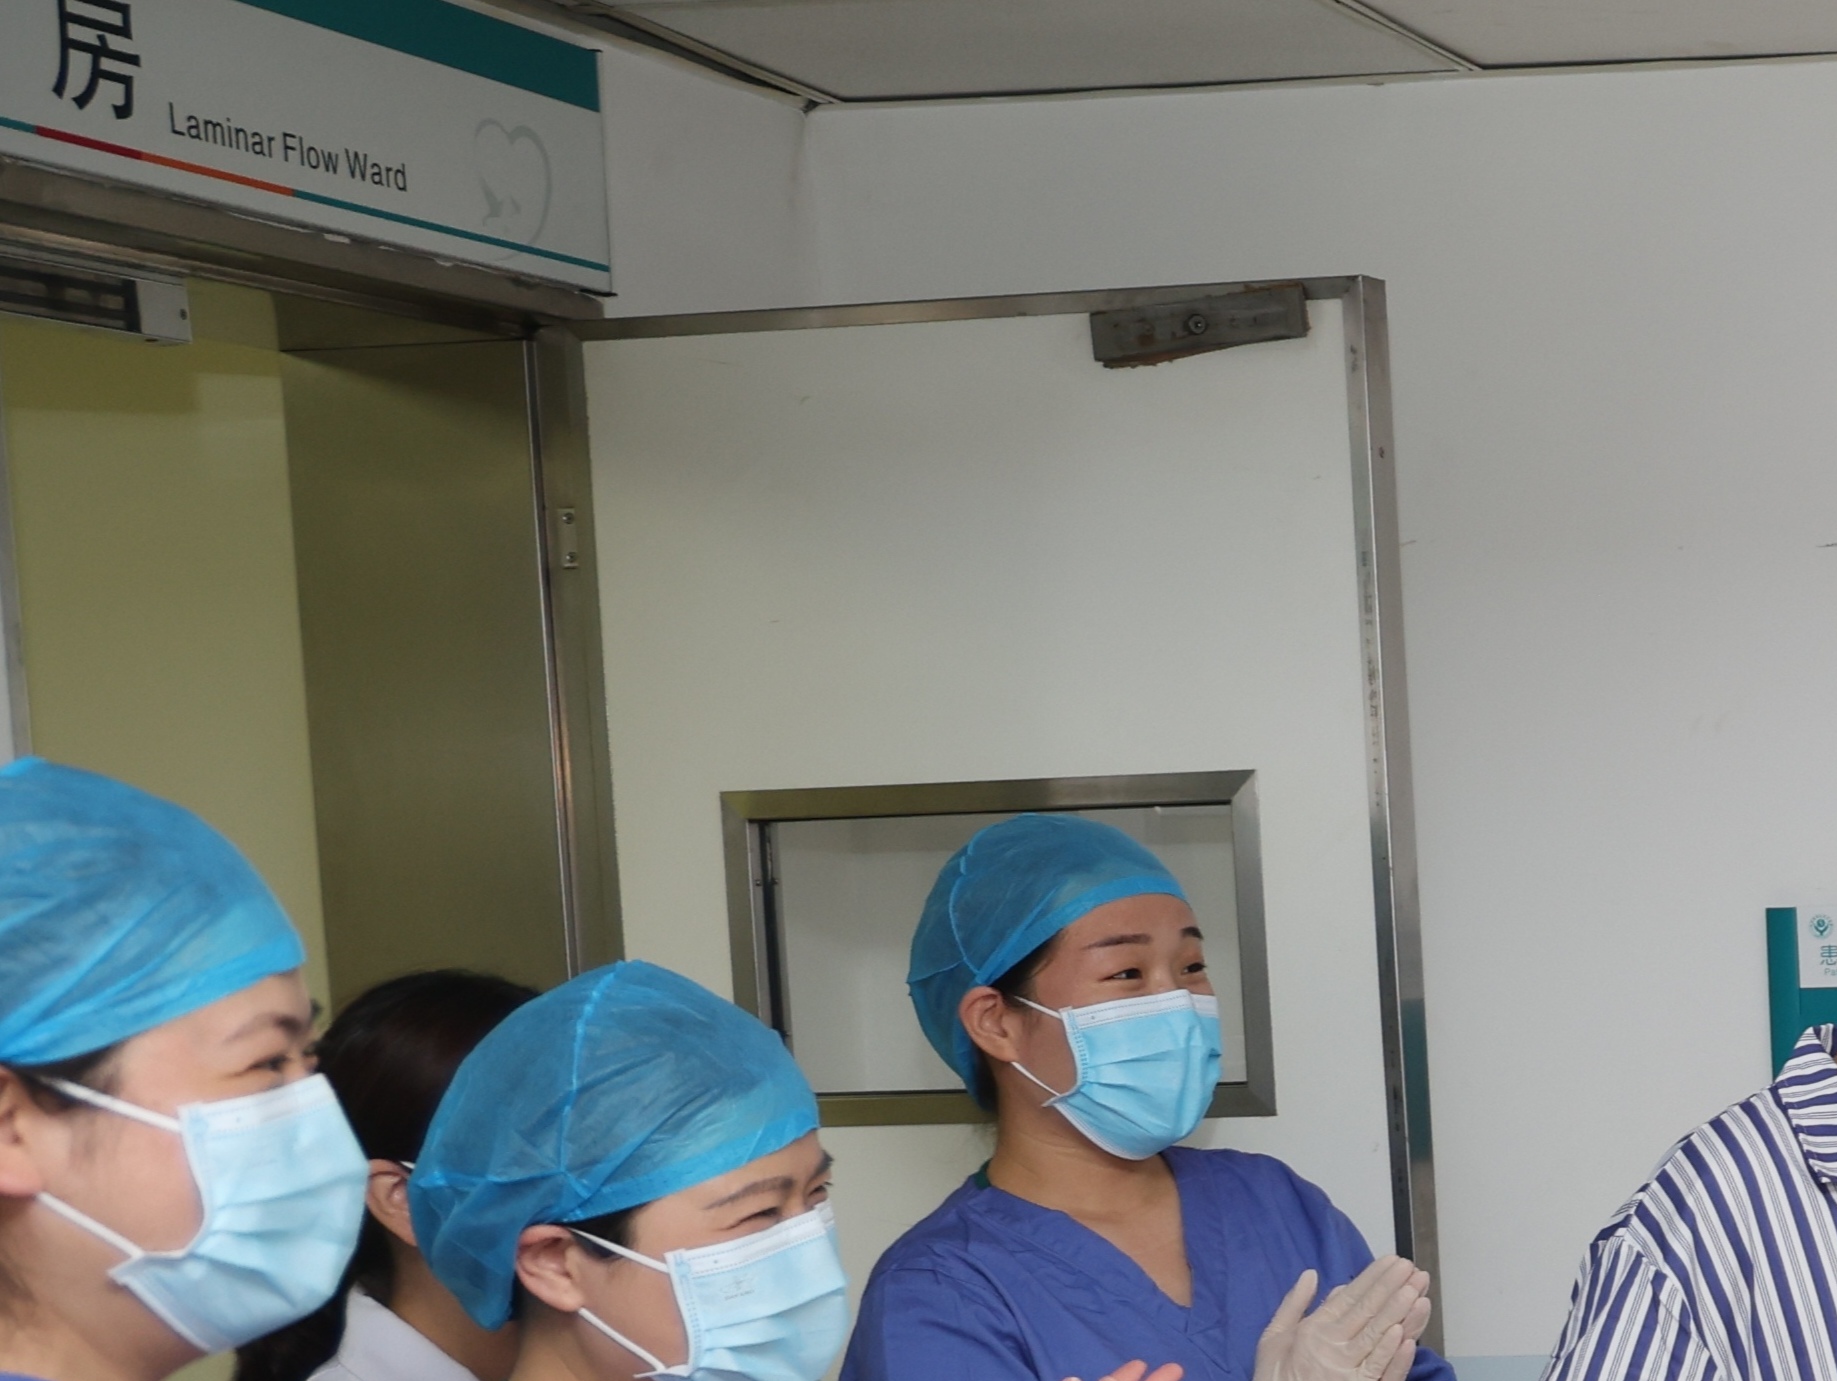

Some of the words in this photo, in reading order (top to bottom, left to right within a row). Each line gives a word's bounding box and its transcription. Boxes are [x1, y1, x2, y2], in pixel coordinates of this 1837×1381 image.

[52, 0, 142, 119] 房
[168, 101, 275, 159] Laminar
[282, 132, 339, 175] Flow
[344, 148, 408, 192] Ward
